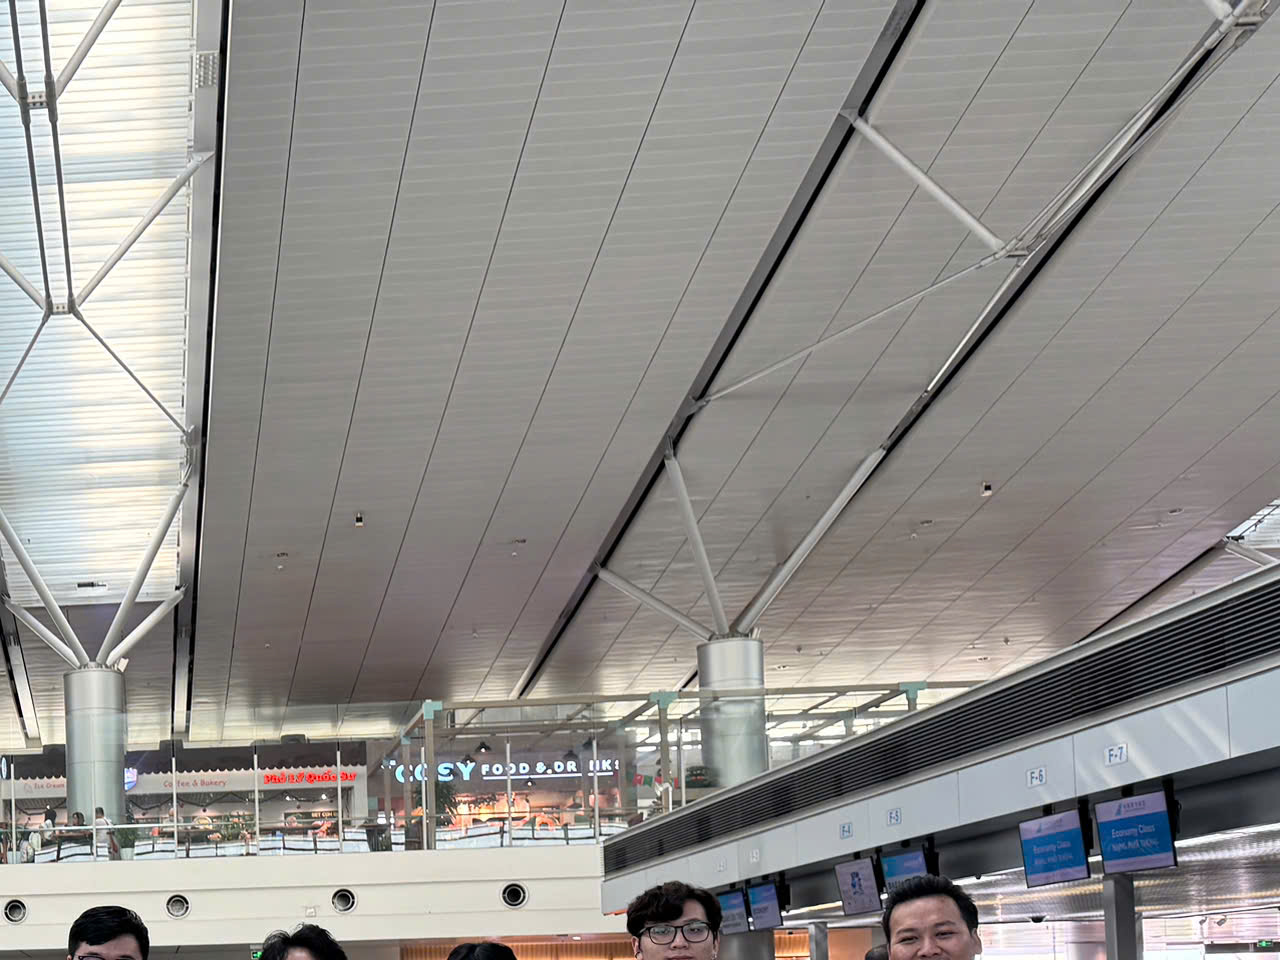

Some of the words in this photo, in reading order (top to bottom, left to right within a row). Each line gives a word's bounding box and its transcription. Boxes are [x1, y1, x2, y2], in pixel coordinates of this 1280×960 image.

[481, 763, 530, 776] FOOD
[535, 762, 547, 774] &
[200, 779, 226, 788] Bakery
